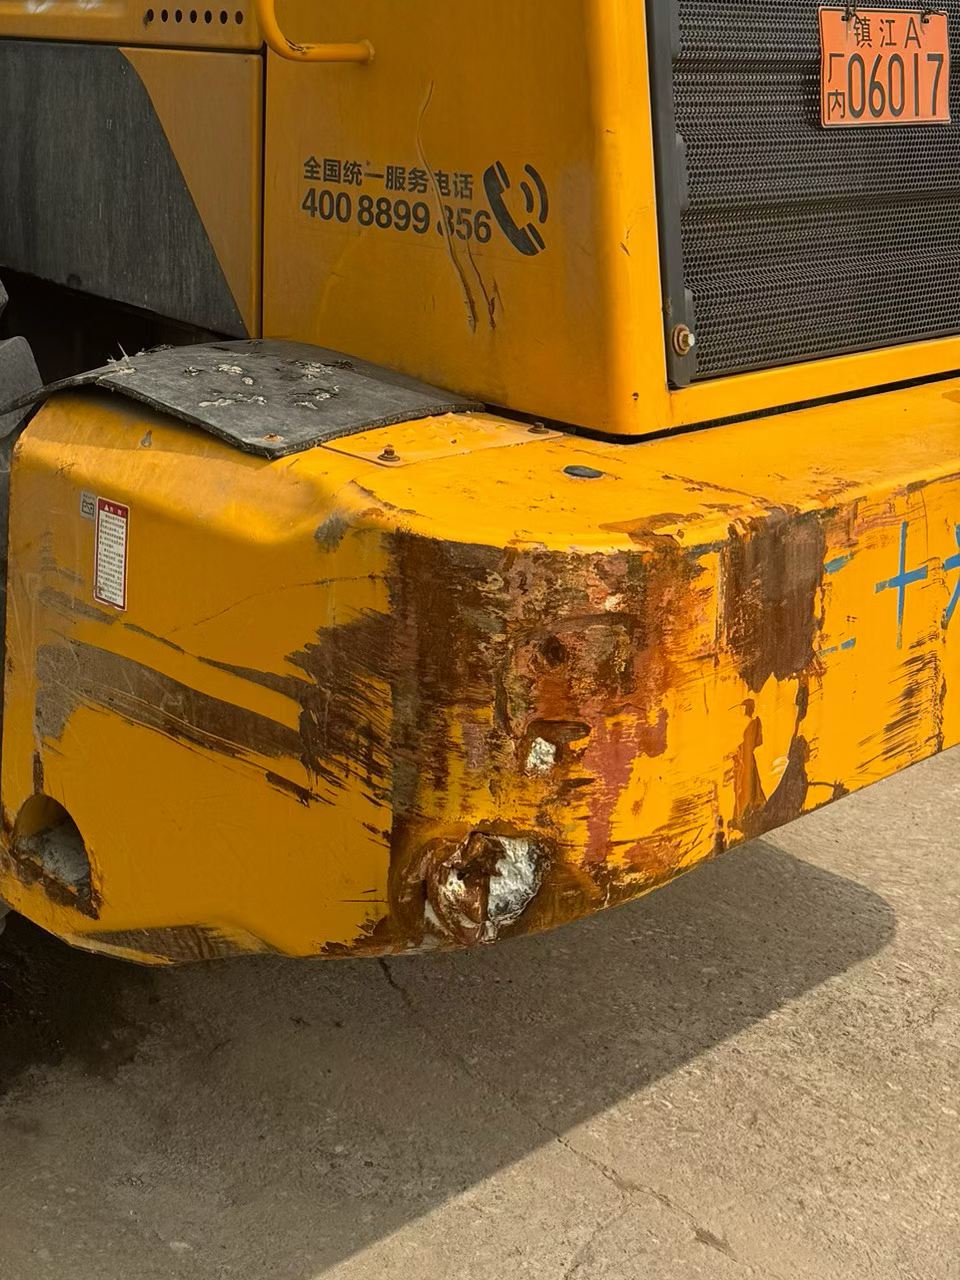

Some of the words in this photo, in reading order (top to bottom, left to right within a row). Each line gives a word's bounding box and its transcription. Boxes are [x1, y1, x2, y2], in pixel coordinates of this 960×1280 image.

[847, 52, 944, 119] 06017
[303, 156, 474, 200] 全国统一服务电话
[301, 188, 352, 223] 400
